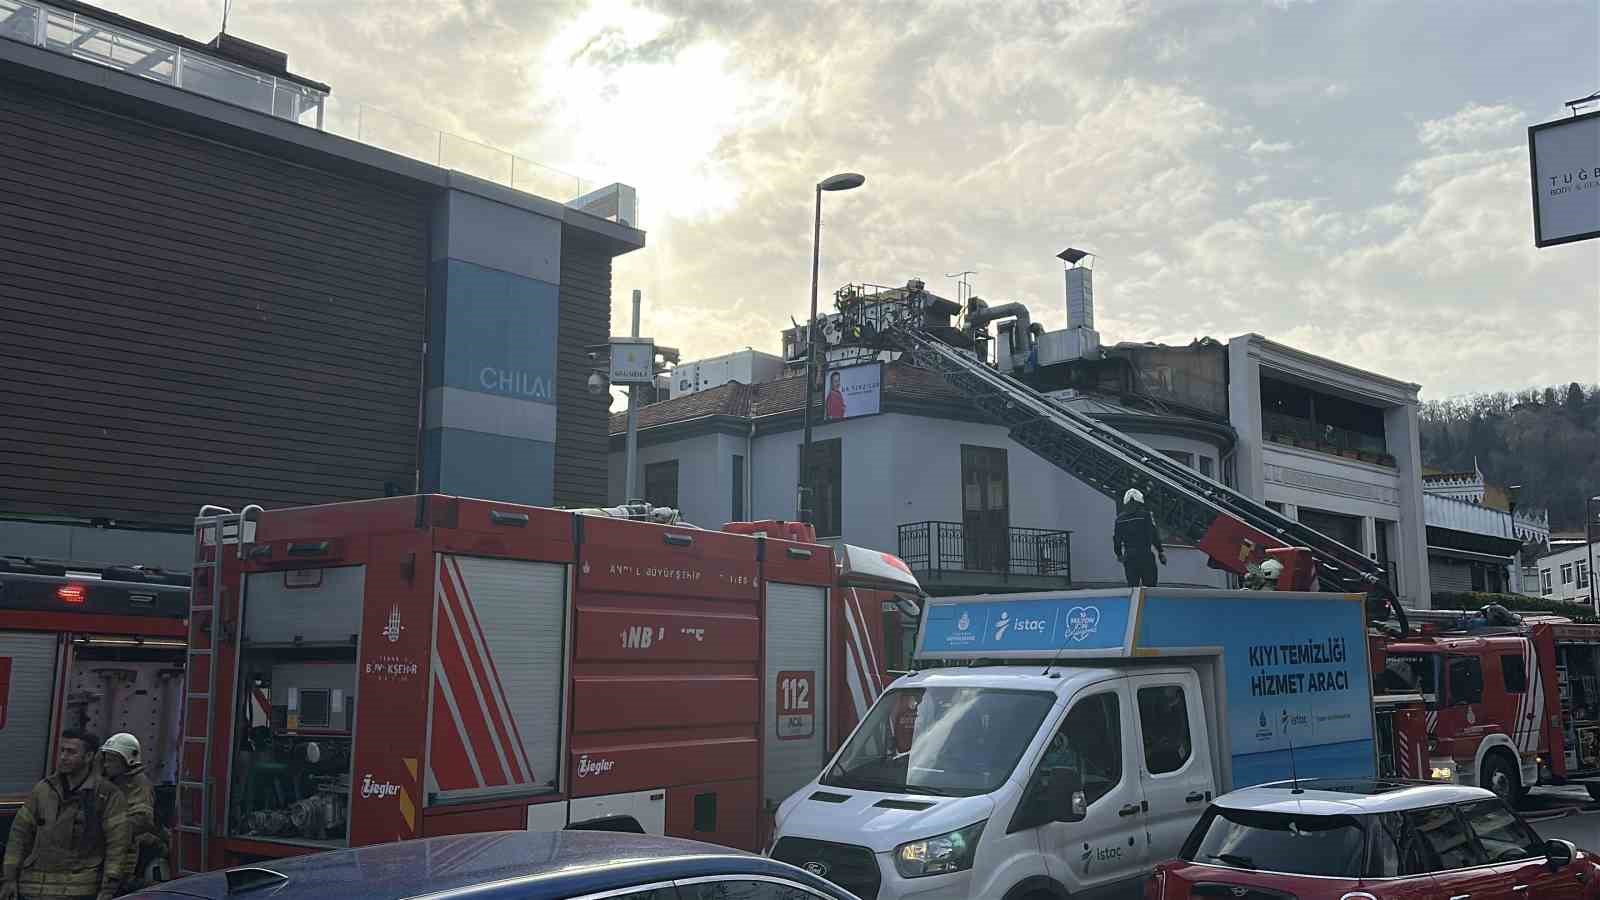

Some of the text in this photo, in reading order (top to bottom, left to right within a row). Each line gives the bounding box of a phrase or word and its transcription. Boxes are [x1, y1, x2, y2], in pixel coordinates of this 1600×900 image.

[480, 367, 553, 399] CHILAI
[1249, 637, 1346, 667] KIYI TEMİZLİĞİ
[783, 678, 809, 709] 112
[1251, 669, 1349, 697] HİZMET ARACI
